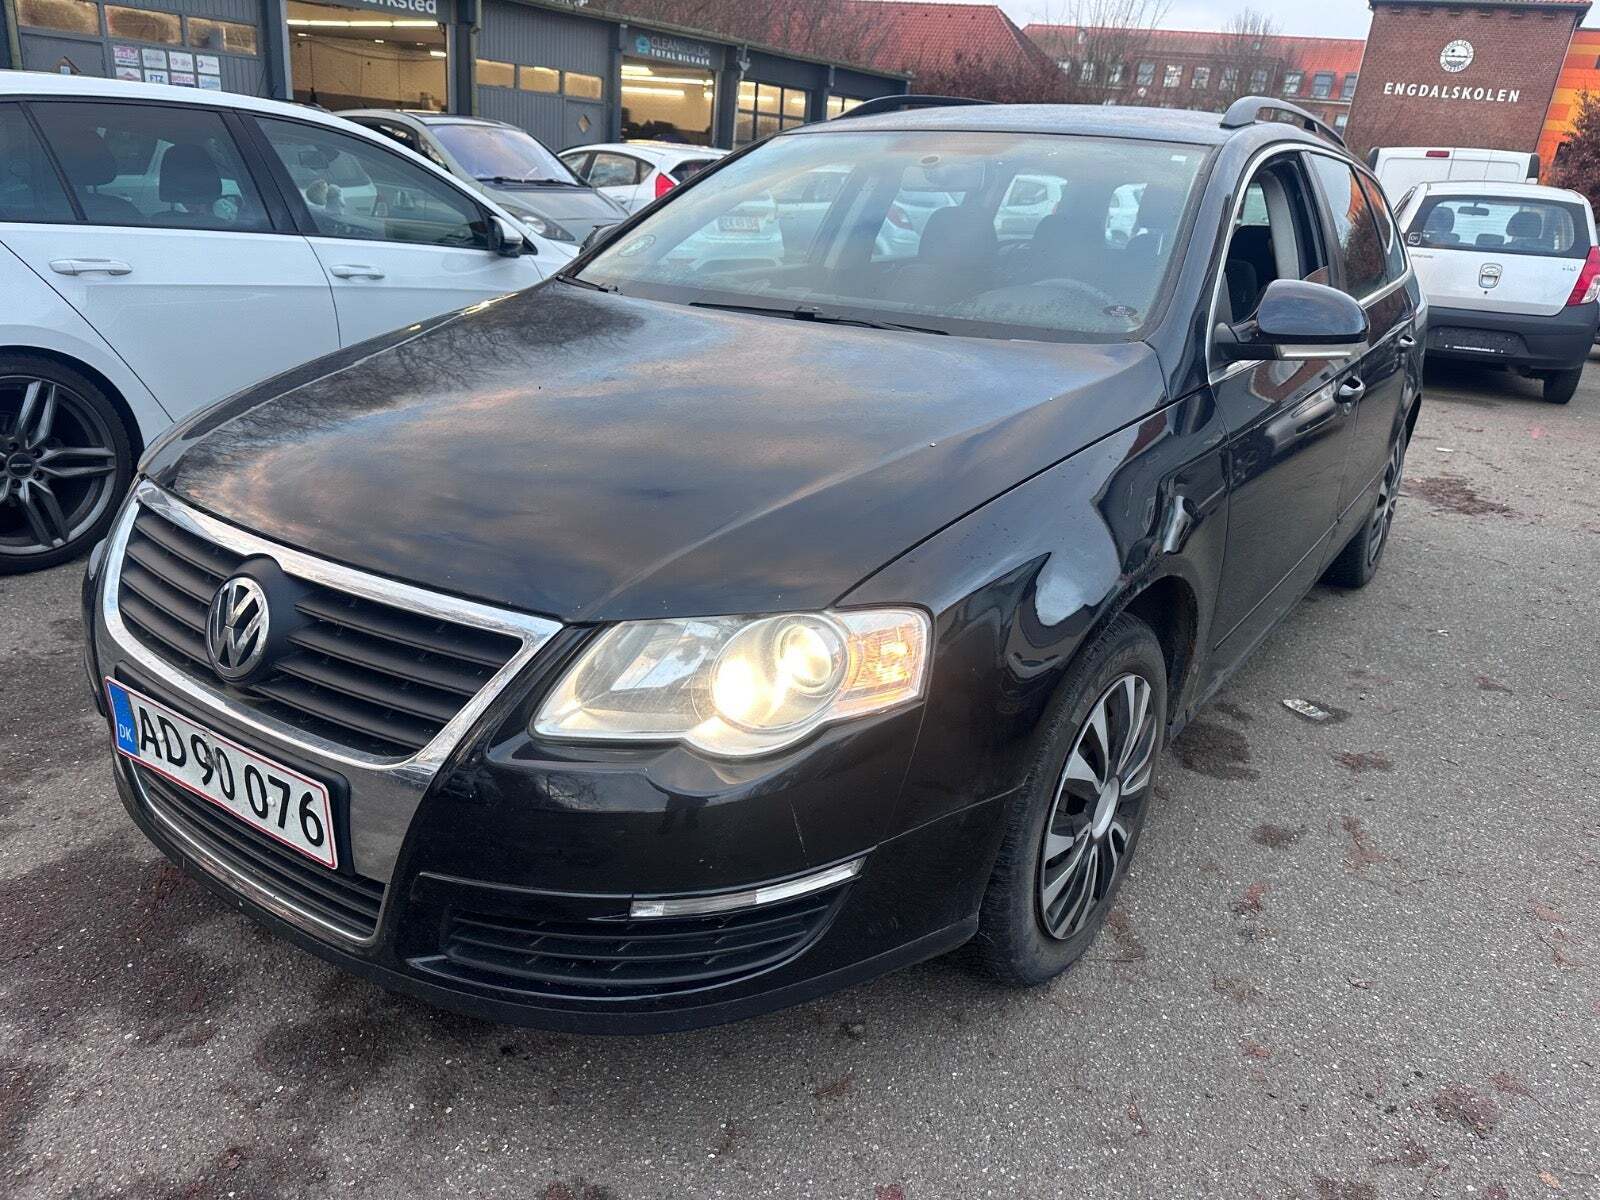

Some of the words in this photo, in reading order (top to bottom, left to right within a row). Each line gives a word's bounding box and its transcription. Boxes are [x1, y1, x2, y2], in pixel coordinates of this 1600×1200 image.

[1383, 82, 1520, 102] ENGDALSKOLEN
[119, 724, 132, 742] DK
[244, 764, 324, 847] 076
